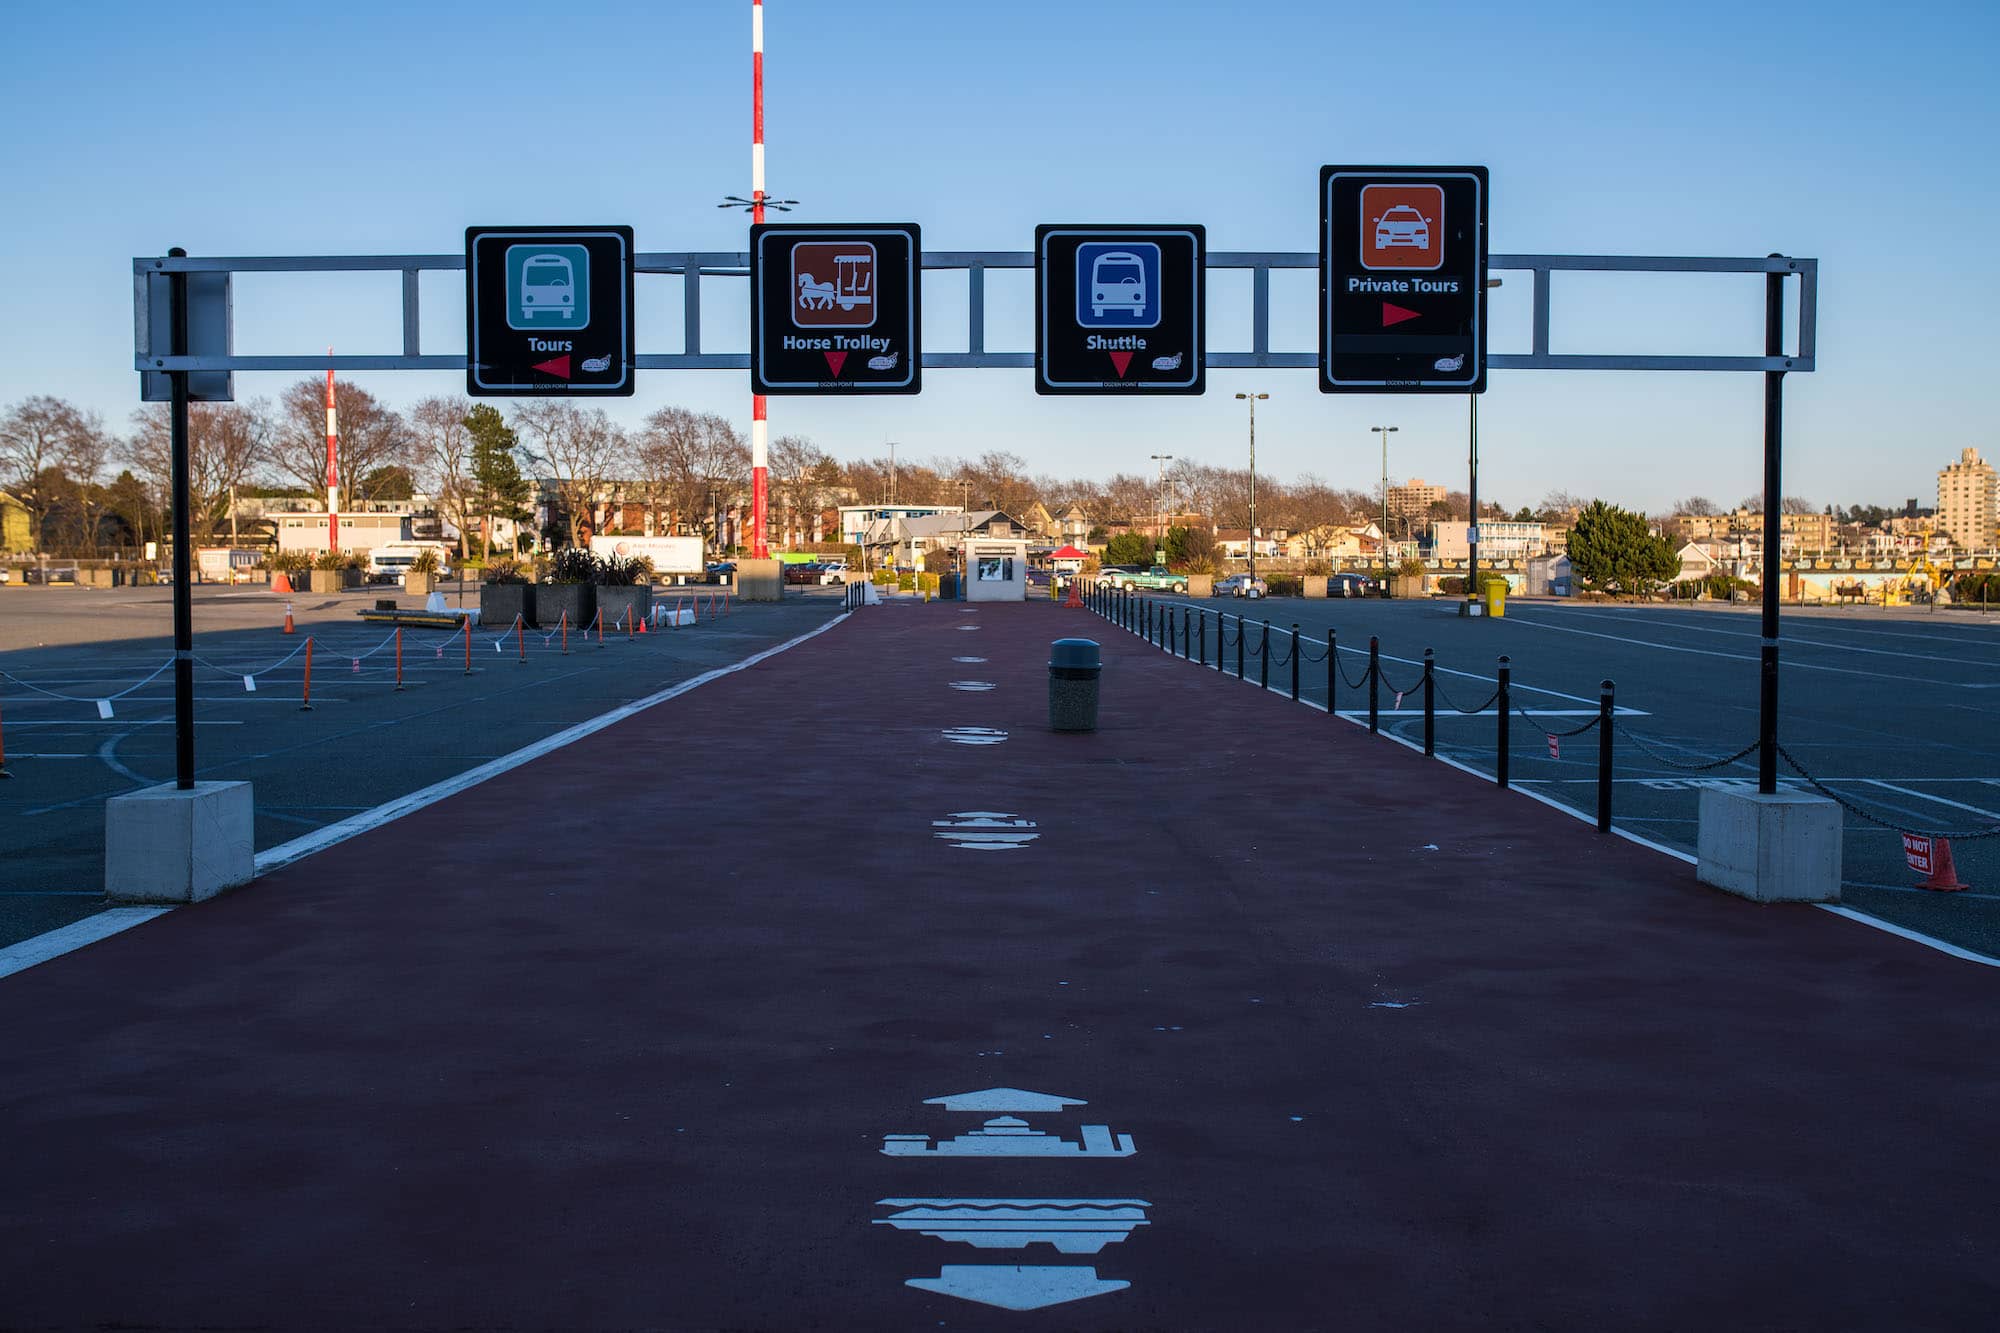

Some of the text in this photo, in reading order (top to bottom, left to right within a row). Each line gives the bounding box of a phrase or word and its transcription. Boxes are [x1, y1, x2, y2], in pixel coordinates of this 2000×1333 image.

[1348, 277, 1459, 293] Private Tours
[527, 337, 573, 352] Tours
[783, 335, 891, 352] Horse Trolley
[1086, 334, 1147, 350] Shuttle
[1912, 839, 1928, 854] NOT
